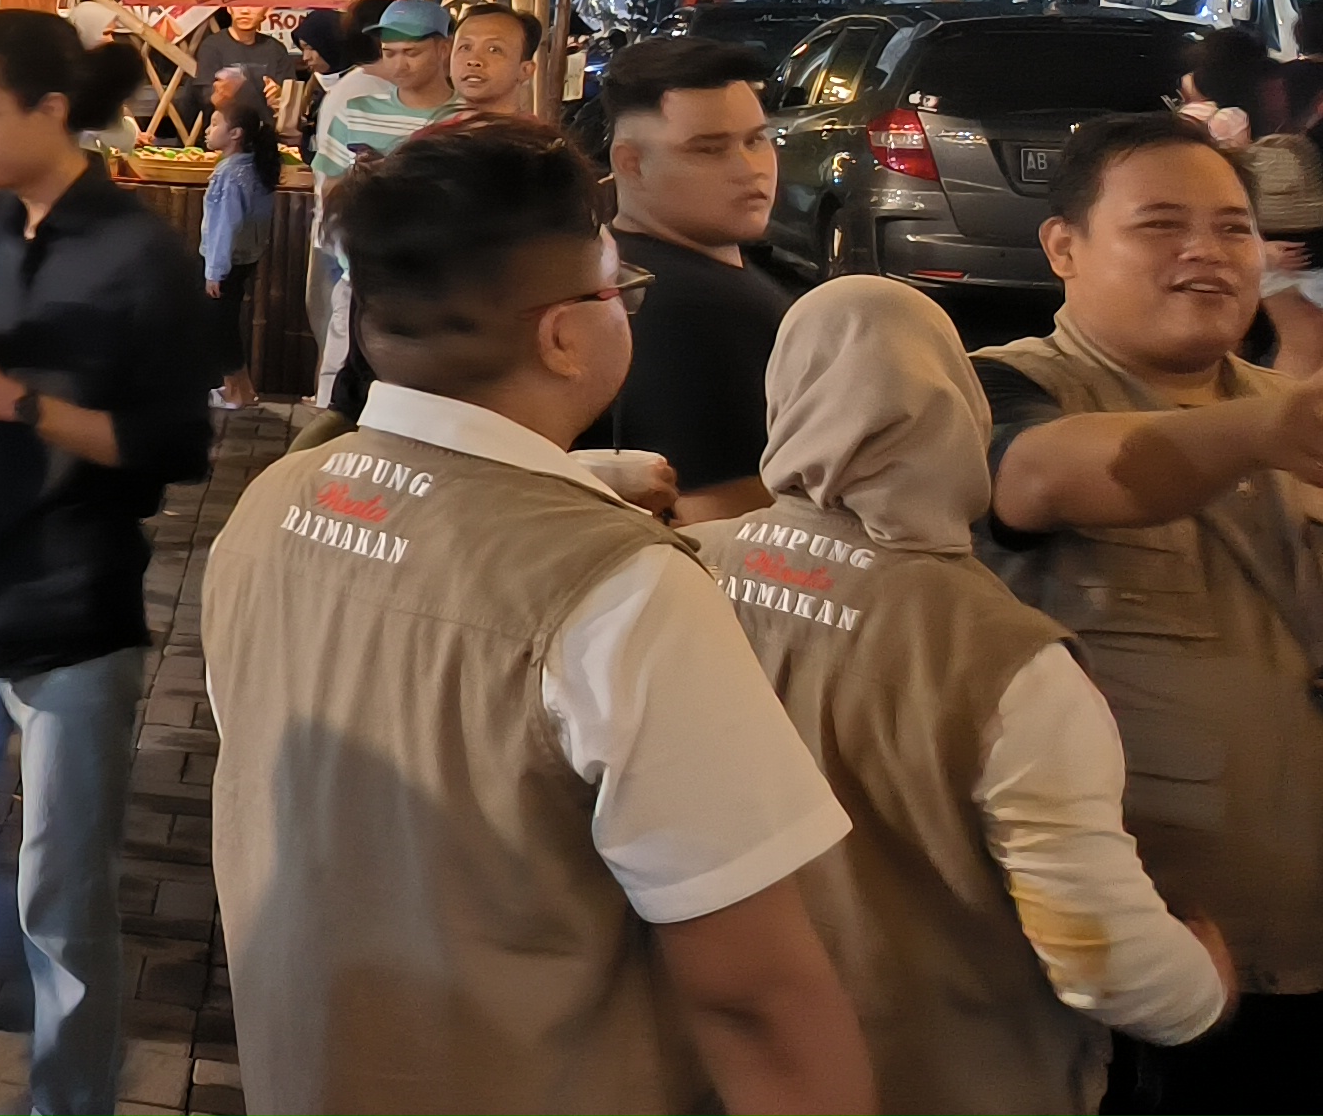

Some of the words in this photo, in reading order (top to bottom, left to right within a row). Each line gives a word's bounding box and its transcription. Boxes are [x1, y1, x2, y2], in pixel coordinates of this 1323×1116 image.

[1026, 151, 1048, 171] AB
[280, 505, 409, 564] RATMAKAN
[735, 522, 876, 570] KAMPUNG
[717, 575, 862, 631] ATMAKAN
